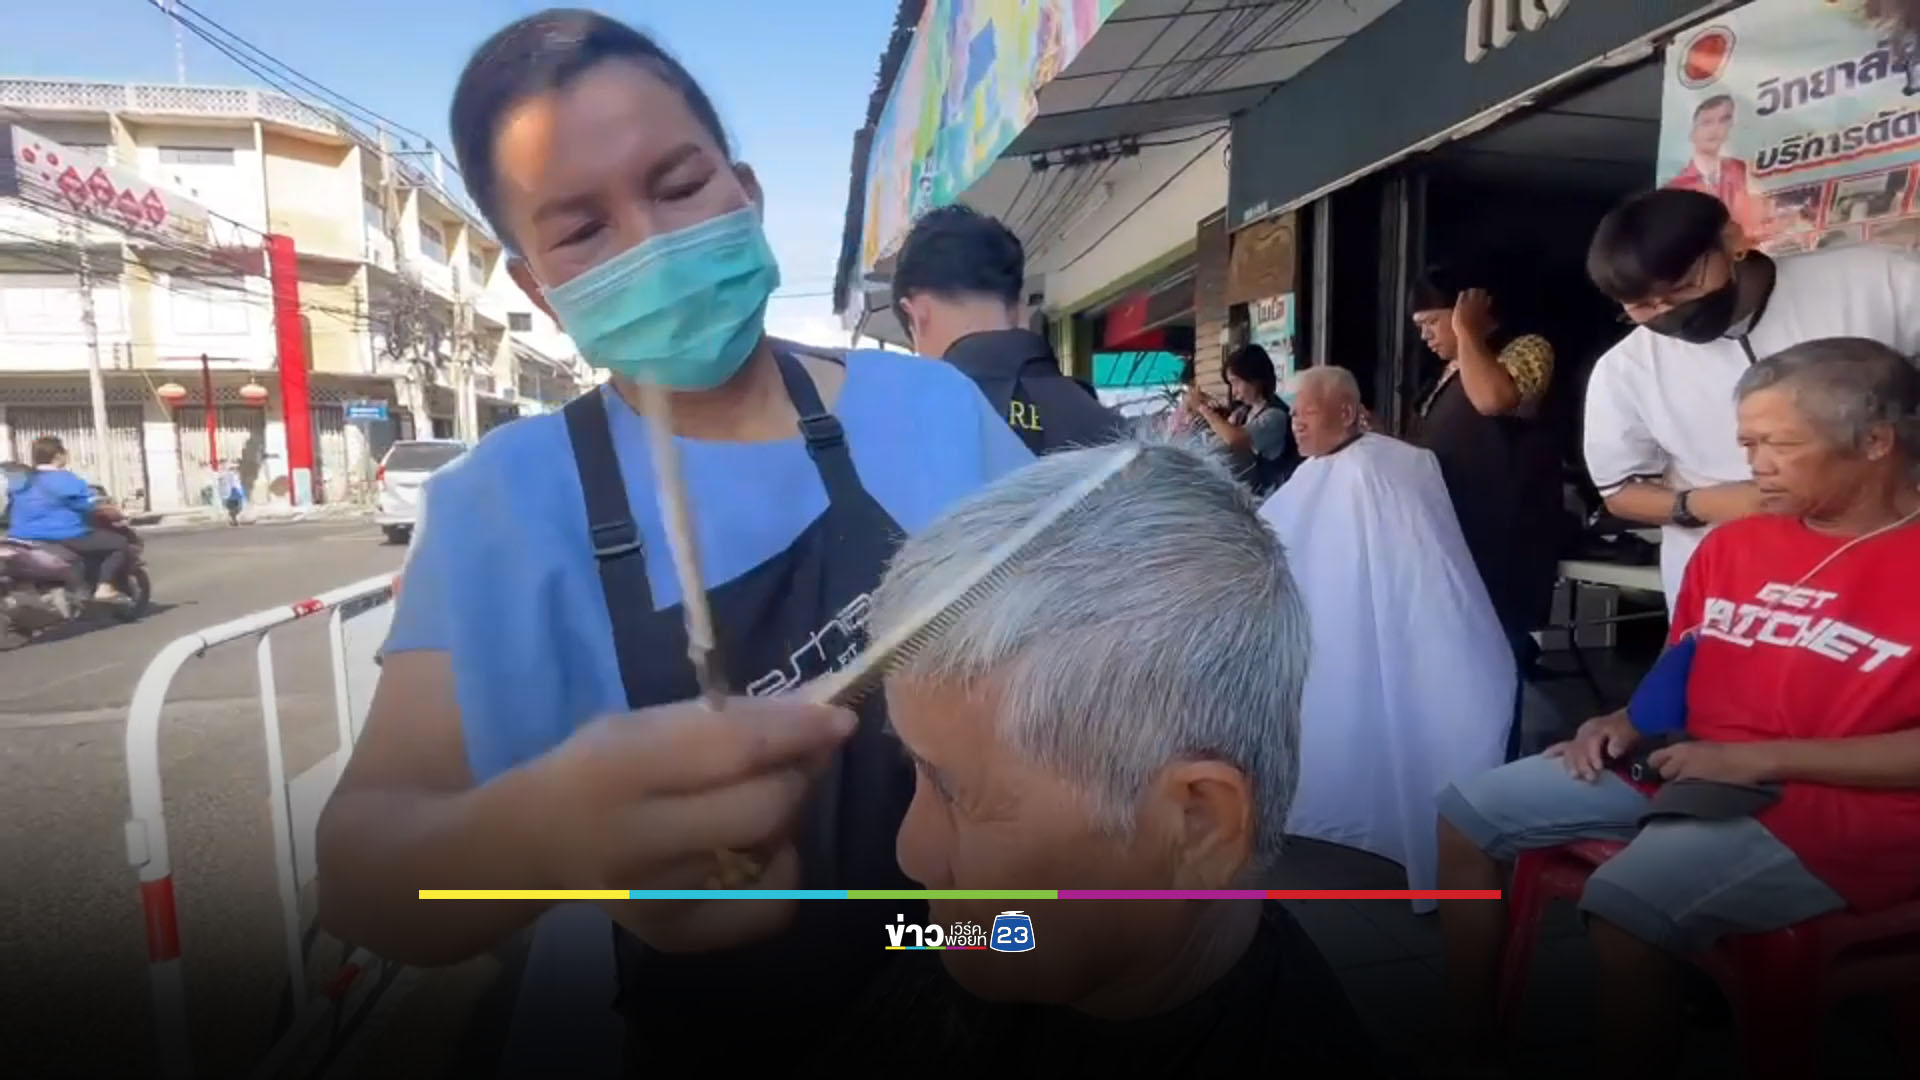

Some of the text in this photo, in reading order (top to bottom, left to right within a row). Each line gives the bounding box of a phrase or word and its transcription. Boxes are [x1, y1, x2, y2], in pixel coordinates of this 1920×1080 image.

[1756, 110, 1920, 171] บริการตัด
[1755, 581, 1839, 609] GET
